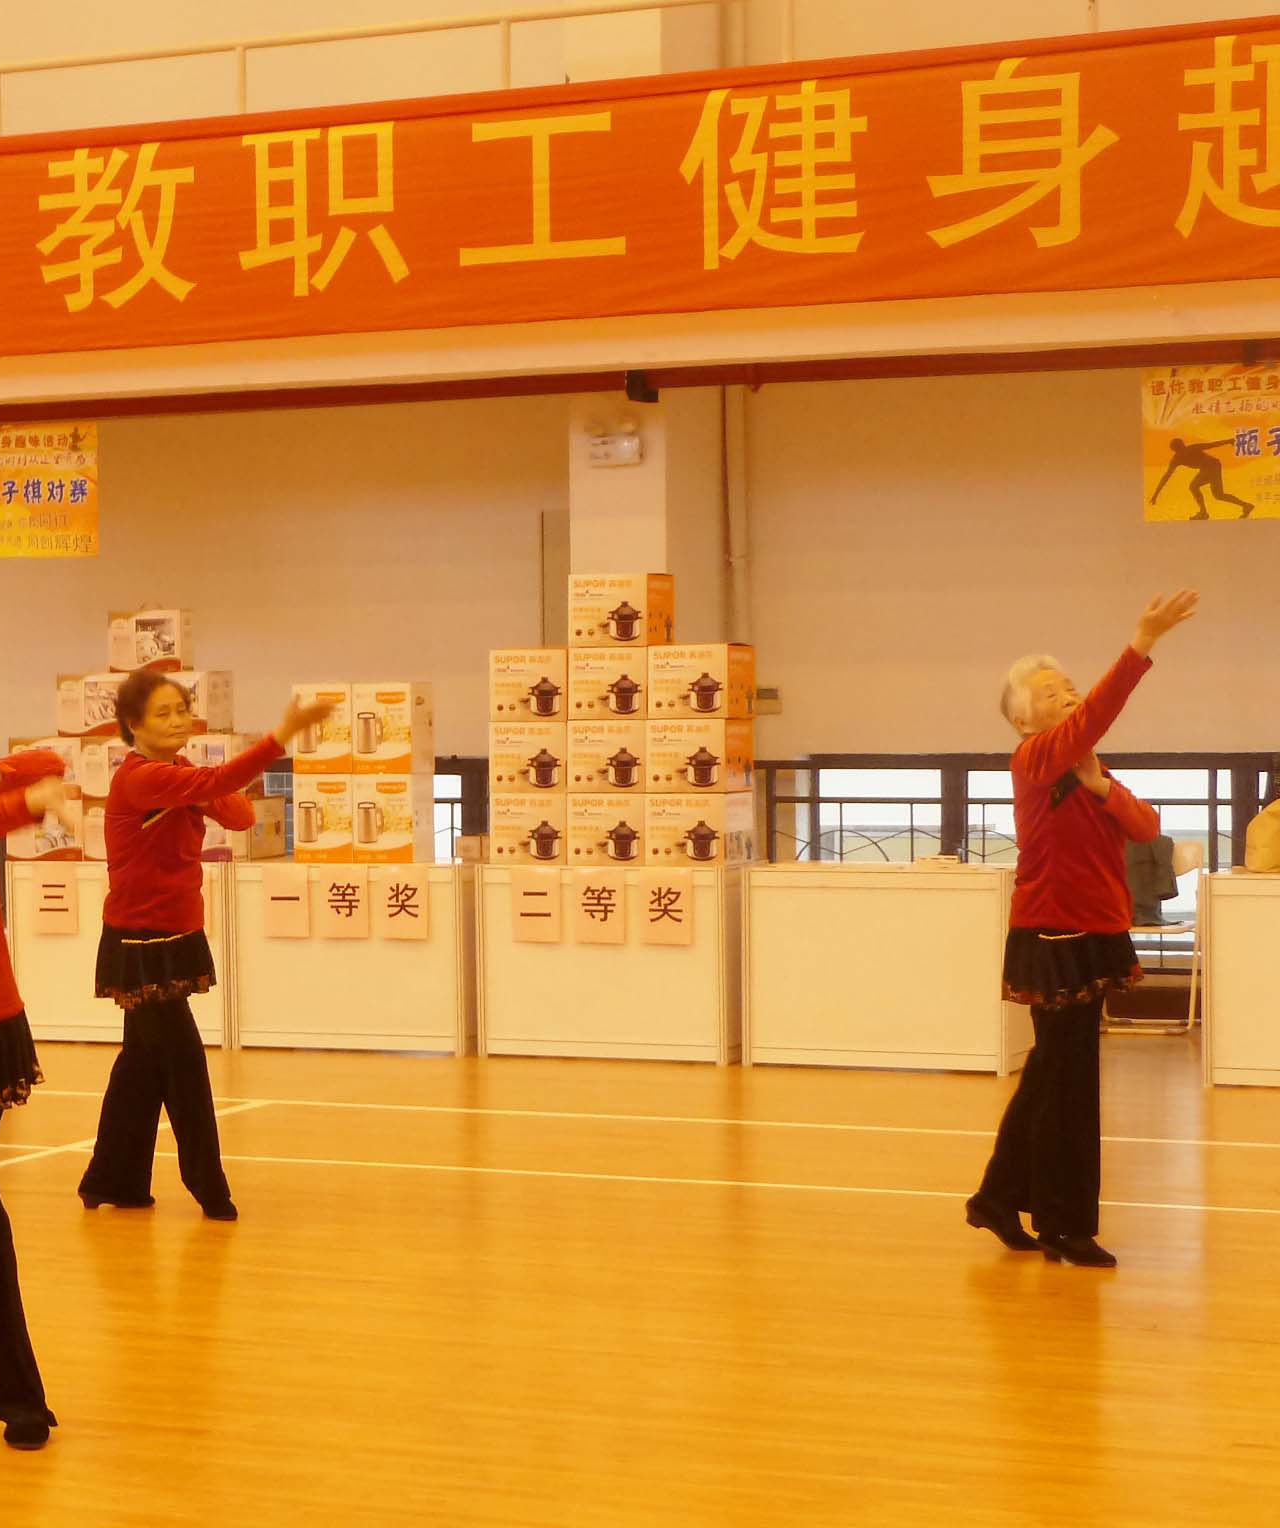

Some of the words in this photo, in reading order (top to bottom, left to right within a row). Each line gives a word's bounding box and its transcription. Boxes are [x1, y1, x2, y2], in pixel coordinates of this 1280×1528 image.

[39, 884, 70, 913] 三
[270, 882, 420, 918] 一等奖
[519, 885, 684, 923] 二等奖
